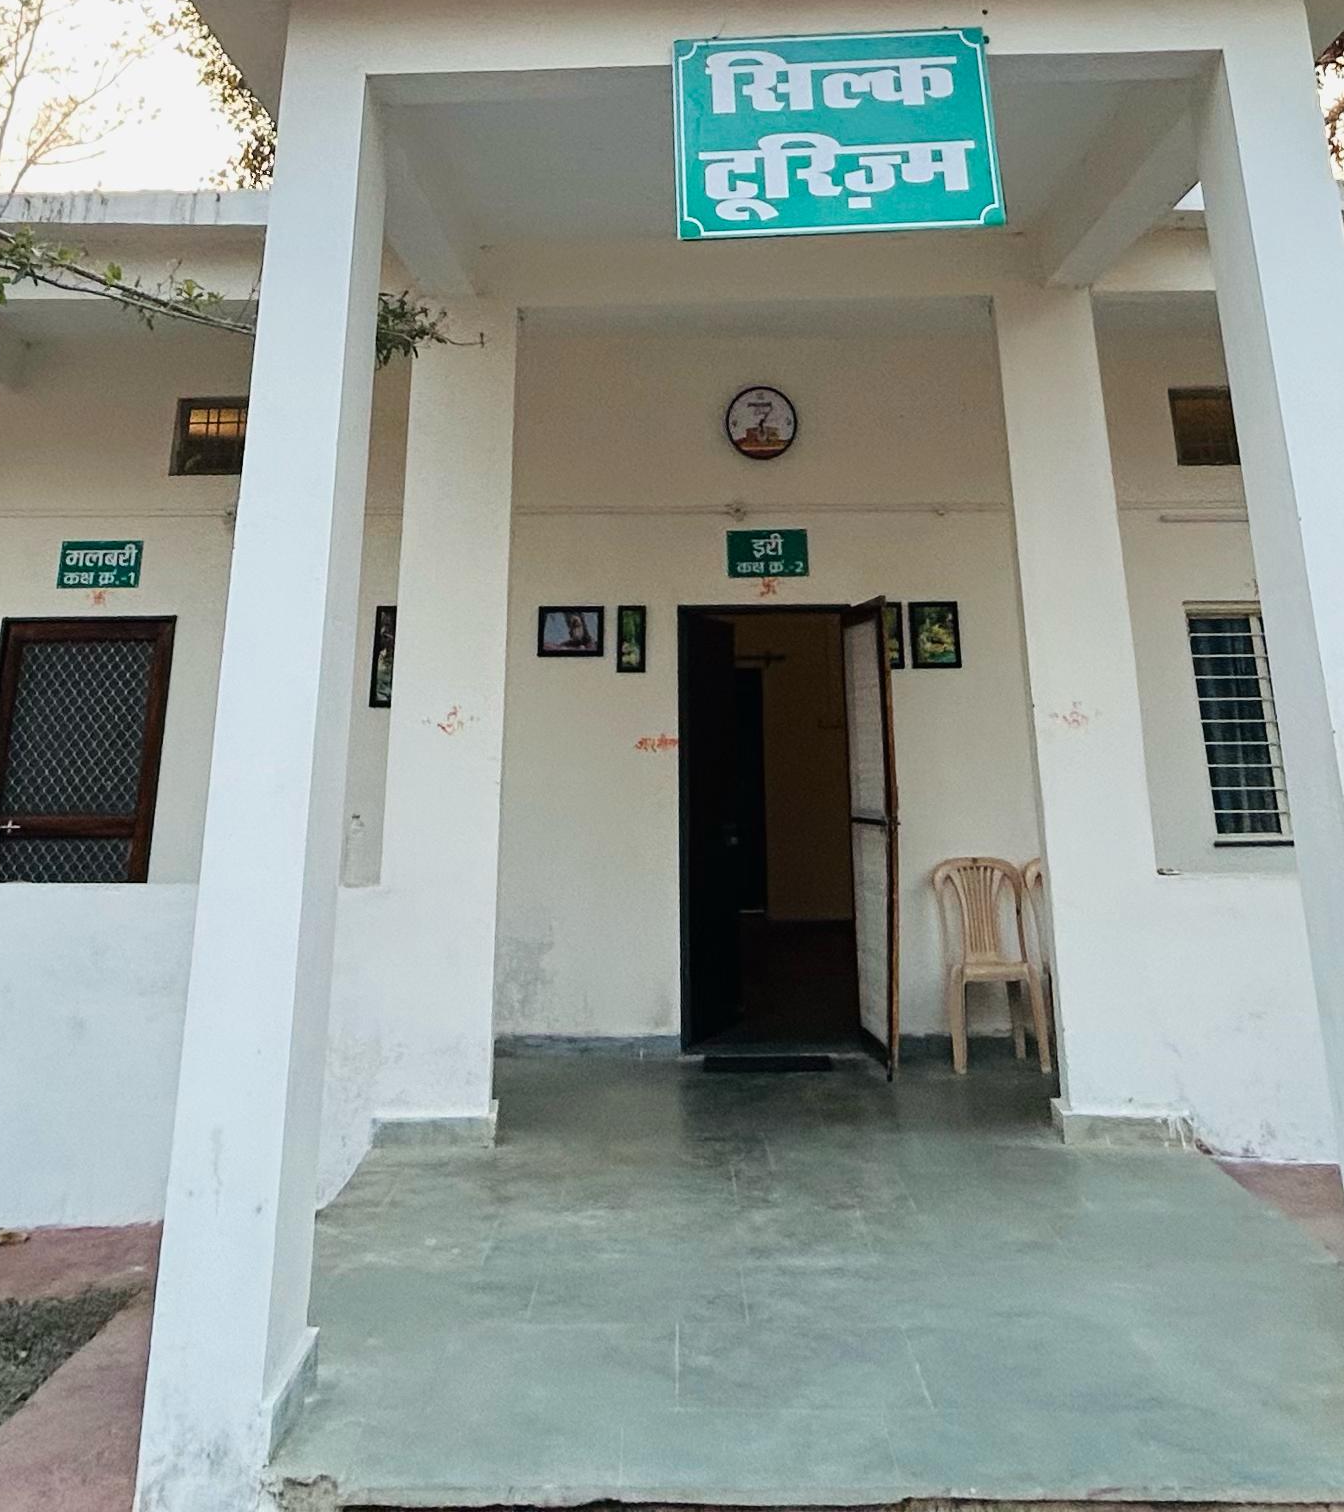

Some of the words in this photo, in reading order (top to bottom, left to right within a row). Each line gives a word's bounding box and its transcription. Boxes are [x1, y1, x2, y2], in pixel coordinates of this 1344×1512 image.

[705, 50, 957, 114] सिल्क
[65, 543, 138, 567] मलबरी
[736, 561, 765, 574] कक्ष
[63, 571, 95, 585] कक्ष
